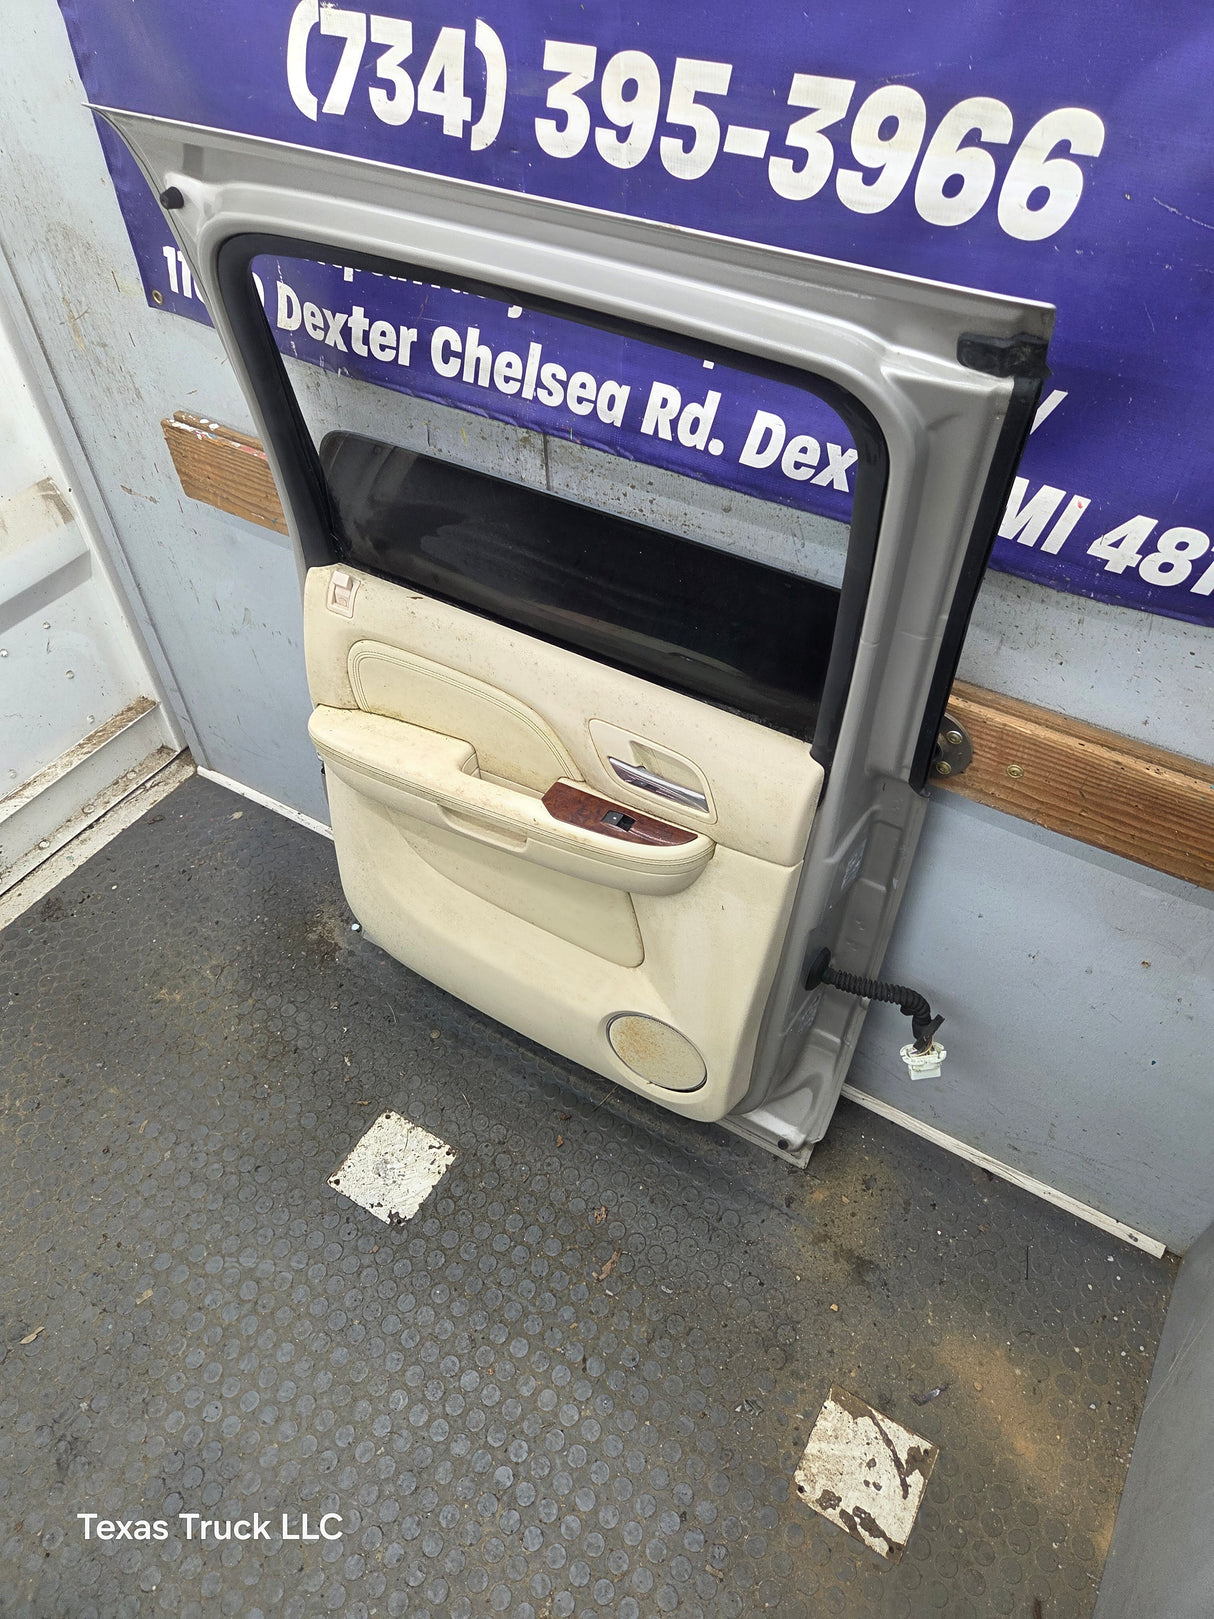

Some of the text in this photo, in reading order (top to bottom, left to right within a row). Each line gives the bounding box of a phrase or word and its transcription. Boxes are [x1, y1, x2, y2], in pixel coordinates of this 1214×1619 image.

[286, 0, 1107, 242] (734) 395-3966
[276, 280, 418, 367] Dexter
[430, 325, 632, 428] Chelsea
[640, 380, 725, 456] Rd.
[738, 409, 859, 493] Dex
[997, 475, 1092, 555] MI
